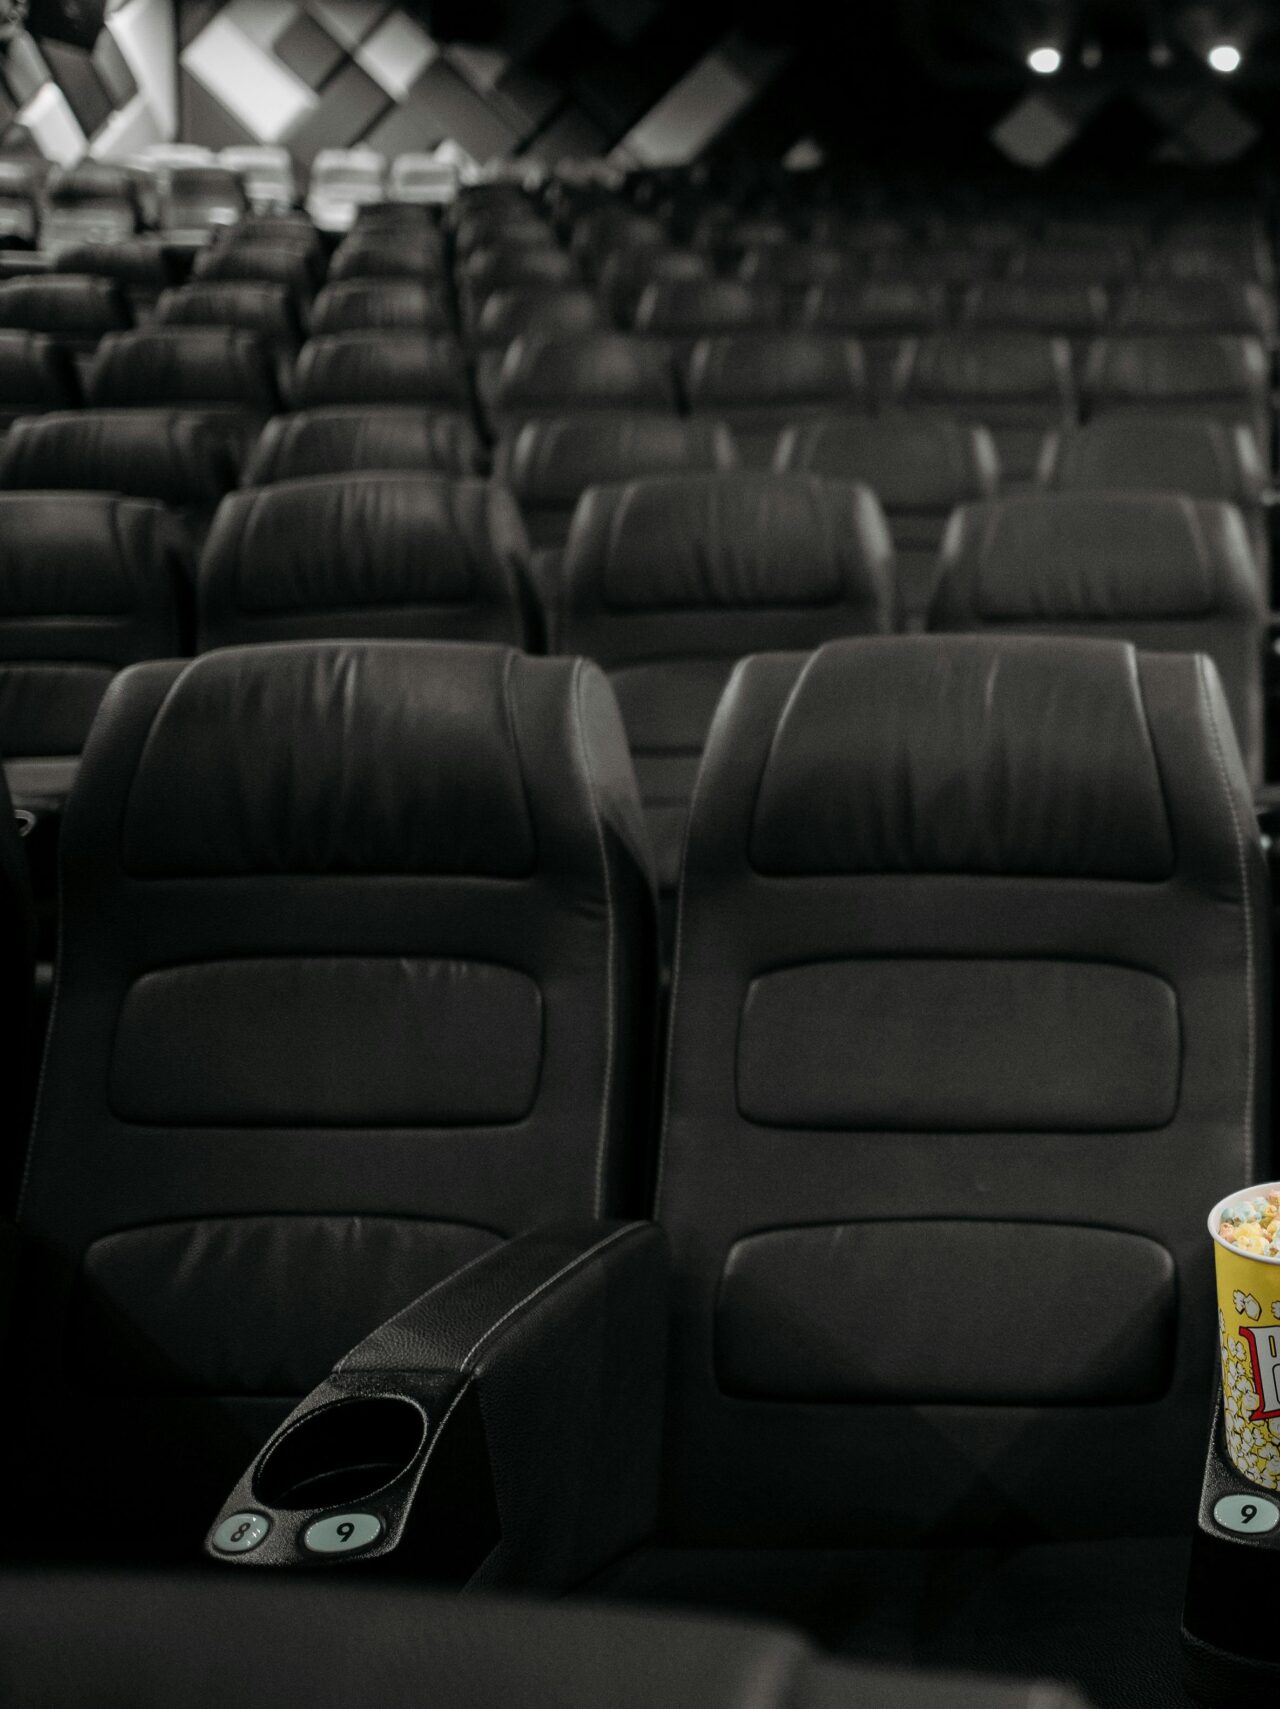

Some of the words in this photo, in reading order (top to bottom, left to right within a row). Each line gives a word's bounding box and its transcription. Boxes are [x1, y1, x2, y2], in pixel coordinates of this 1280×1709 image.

[1240, 1504, 1258, 1524] 9
[230, 1522, 251, 1543] 8
[336, 1522, 355, 1543] 9
